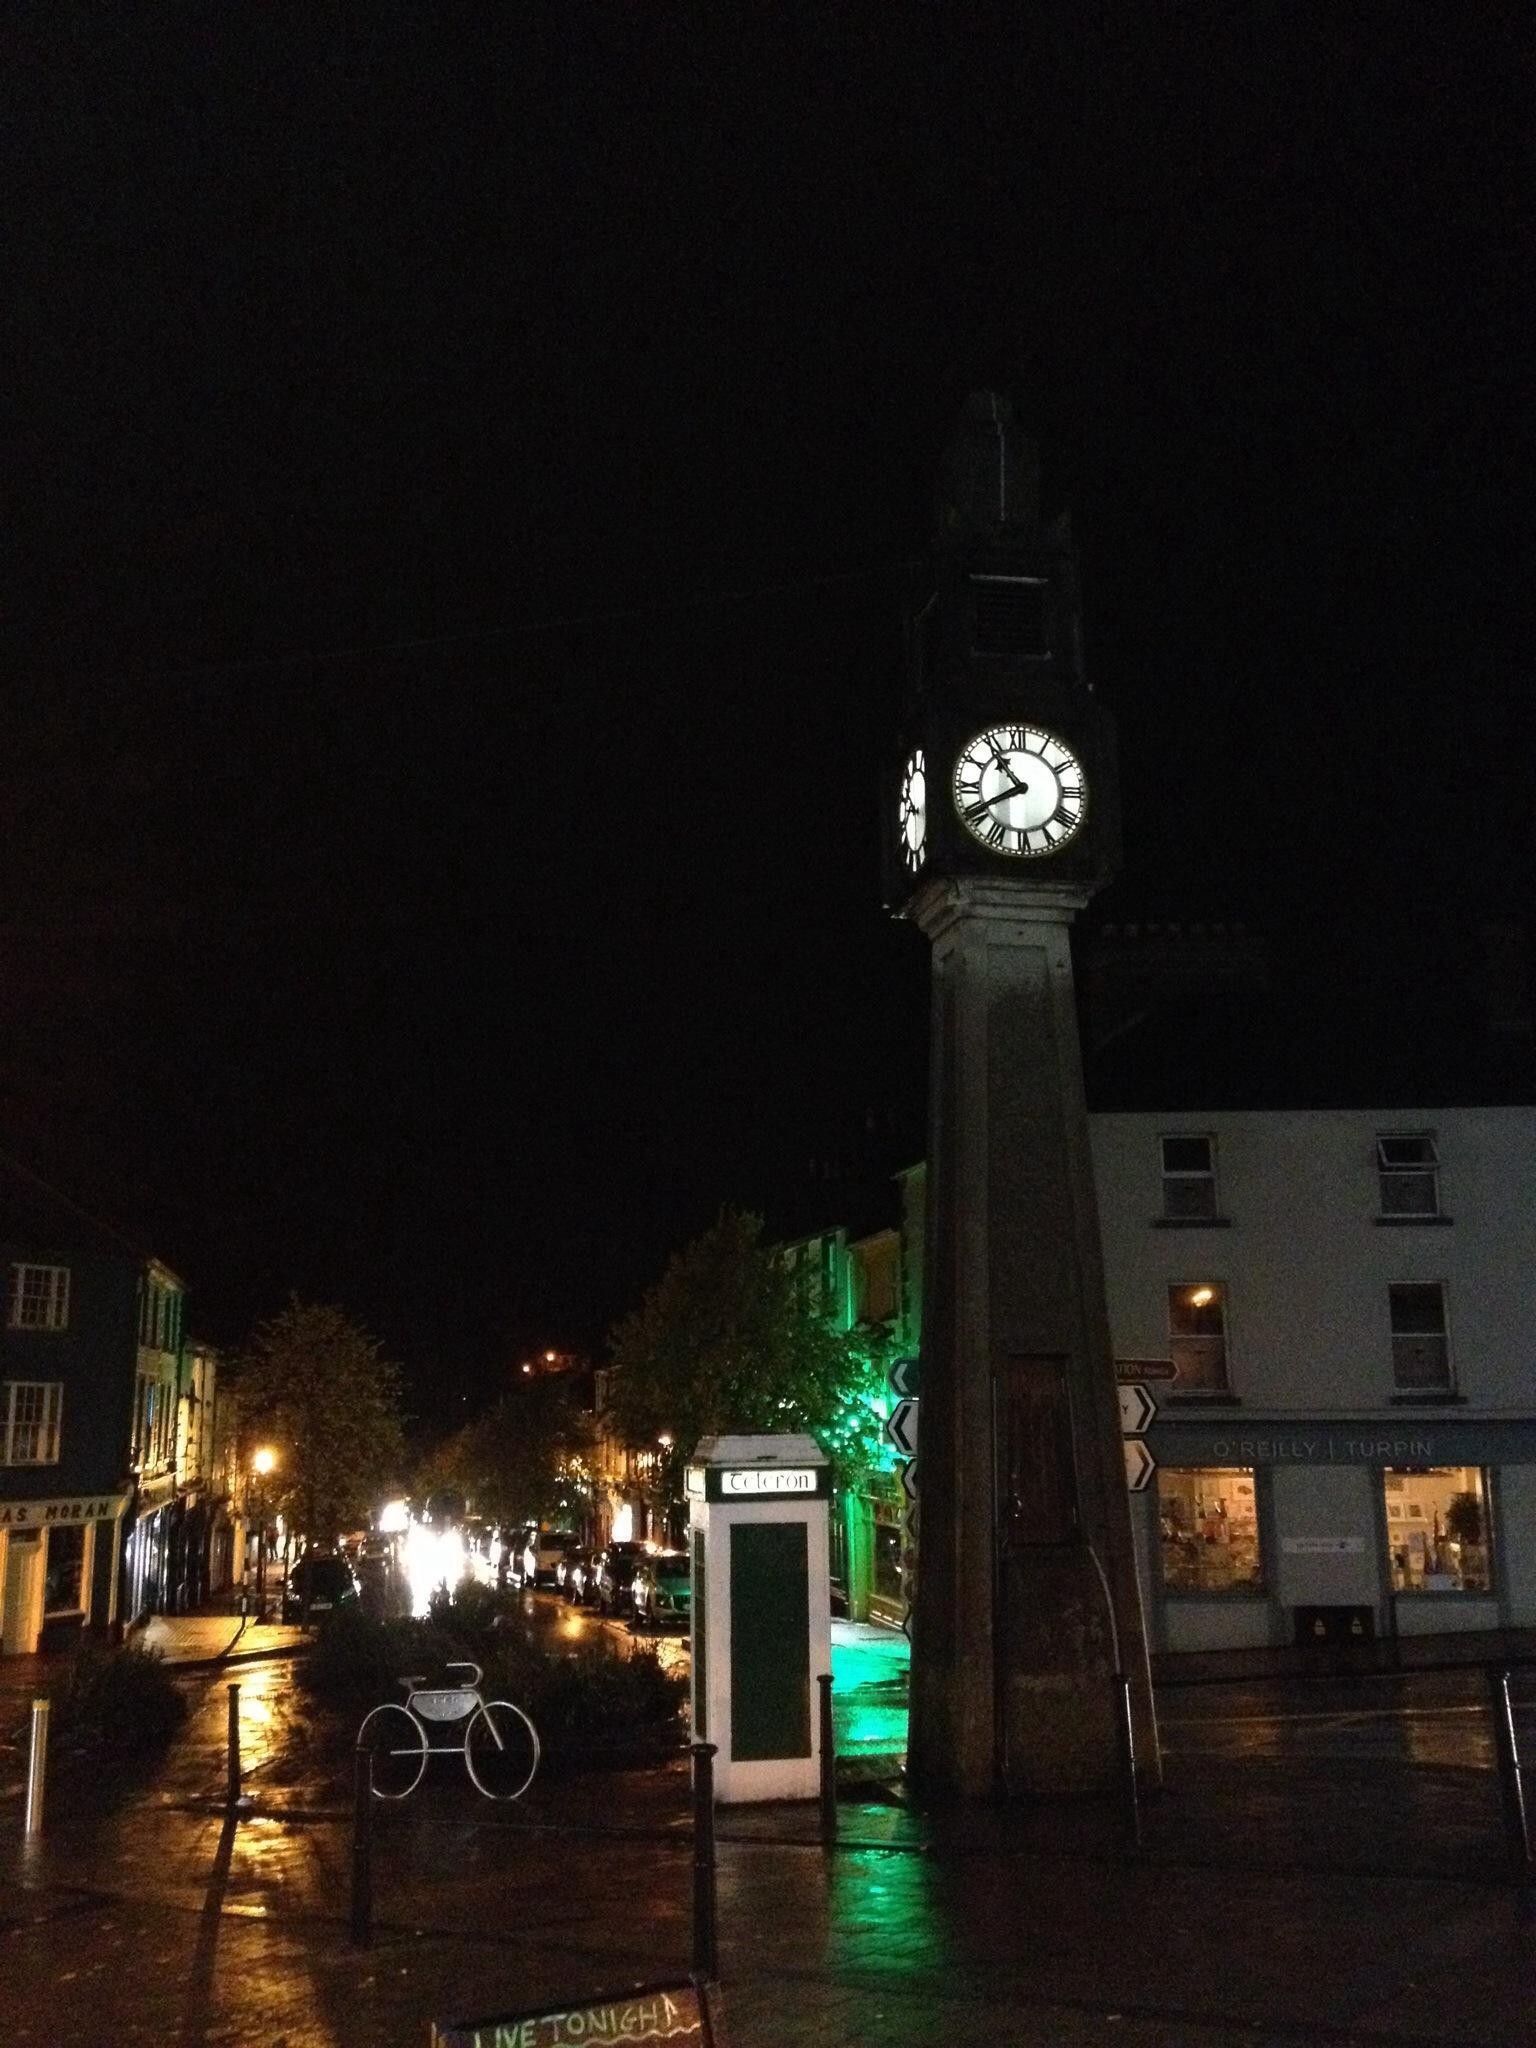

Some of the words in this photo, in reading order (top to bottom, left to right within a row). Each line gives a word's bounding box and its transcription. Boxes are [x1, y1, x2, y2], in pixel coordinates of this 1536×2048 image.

[1009, 730, 1027, 750] XII
[1054, 760, 1073, 774] II
[960, 781, 979, 794] IX
[1062, 787, 1081, 798] III
[1213, 1441, 1315, 1457] O'REILLY
[1344, 1441, 1432, 1457] TURPIN
[45, 1503, 109, 1520] MORAN
[541, 1993, 678, 2041] TONIGHT
